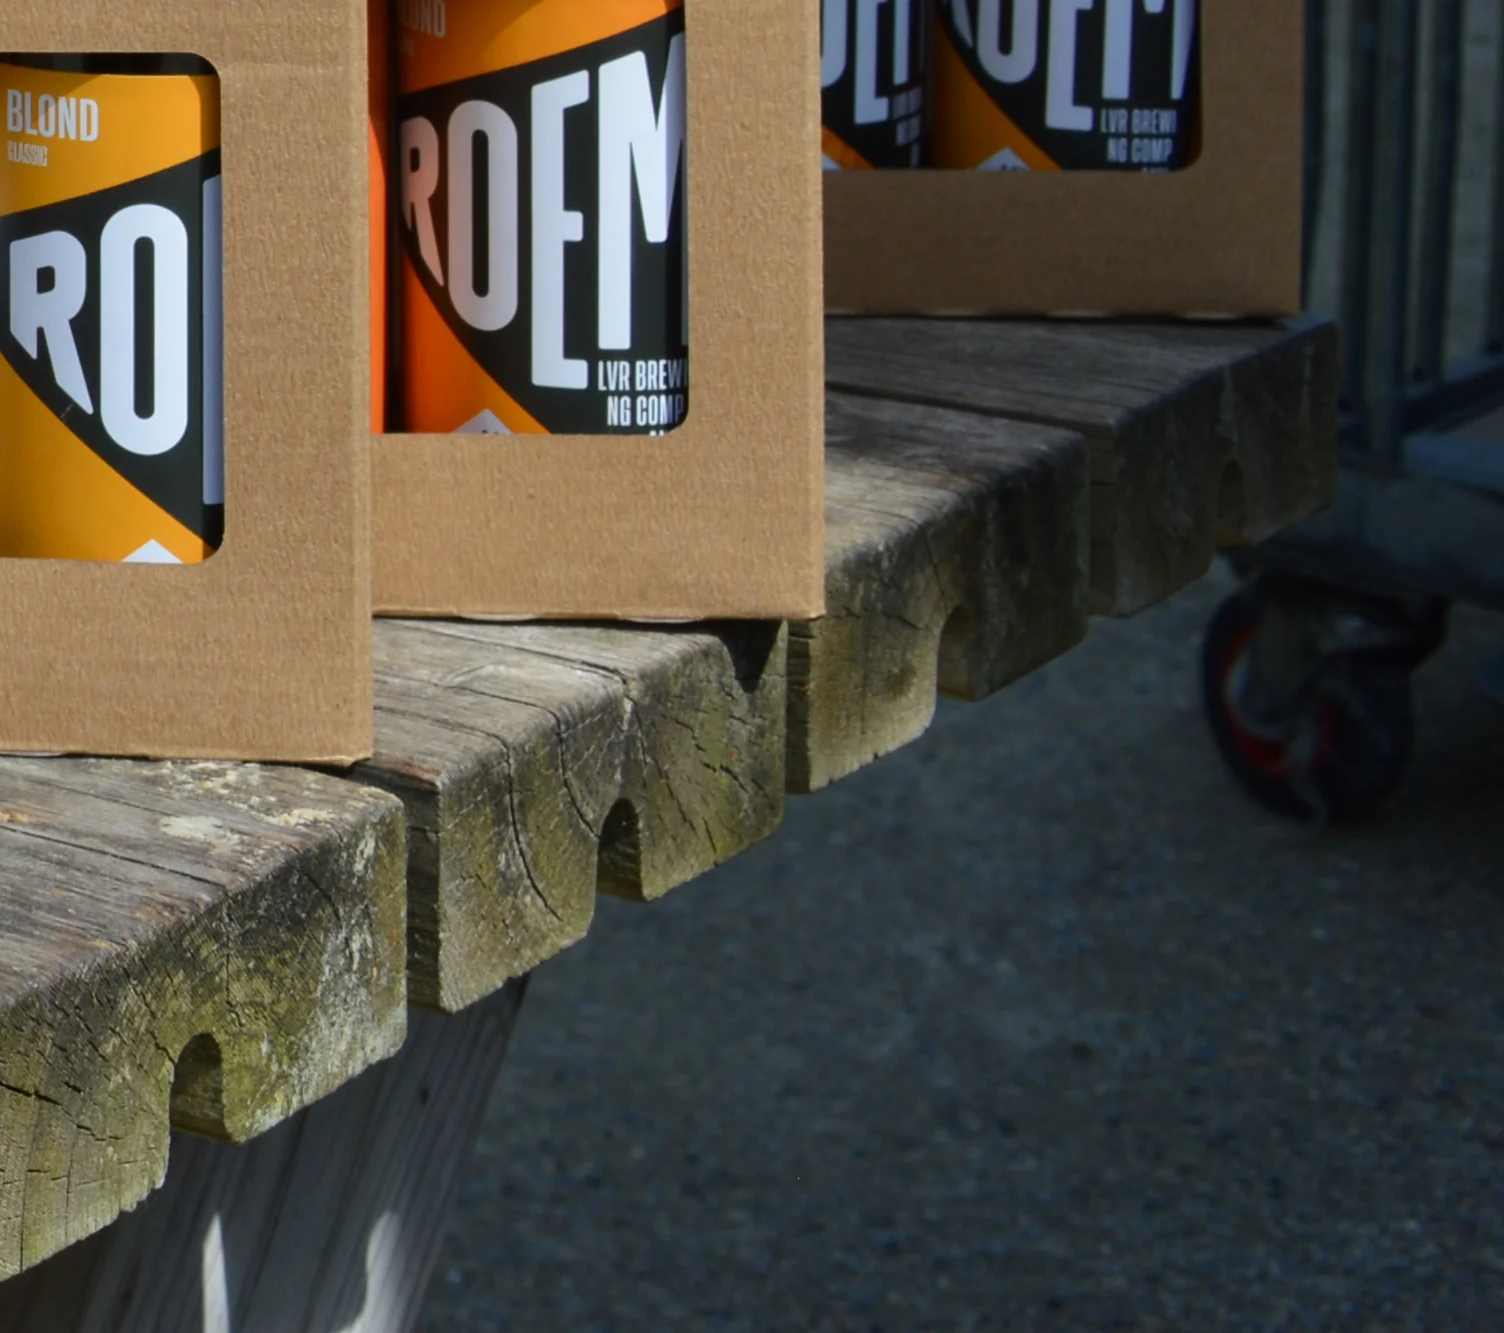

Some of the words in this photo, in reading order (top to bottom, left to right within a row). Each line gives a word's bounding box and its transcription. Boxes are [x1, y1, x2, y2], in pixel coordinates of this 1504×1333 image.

[7, 88, 99, 143] BLOND
[400, 32, 688, 390] ROEM
[598, 360, 631, 391] LVR
[635, 359, 688, 391] BREWI
[607, 395, 632, 427] NG
[636, 394, 683, 427] COMP
